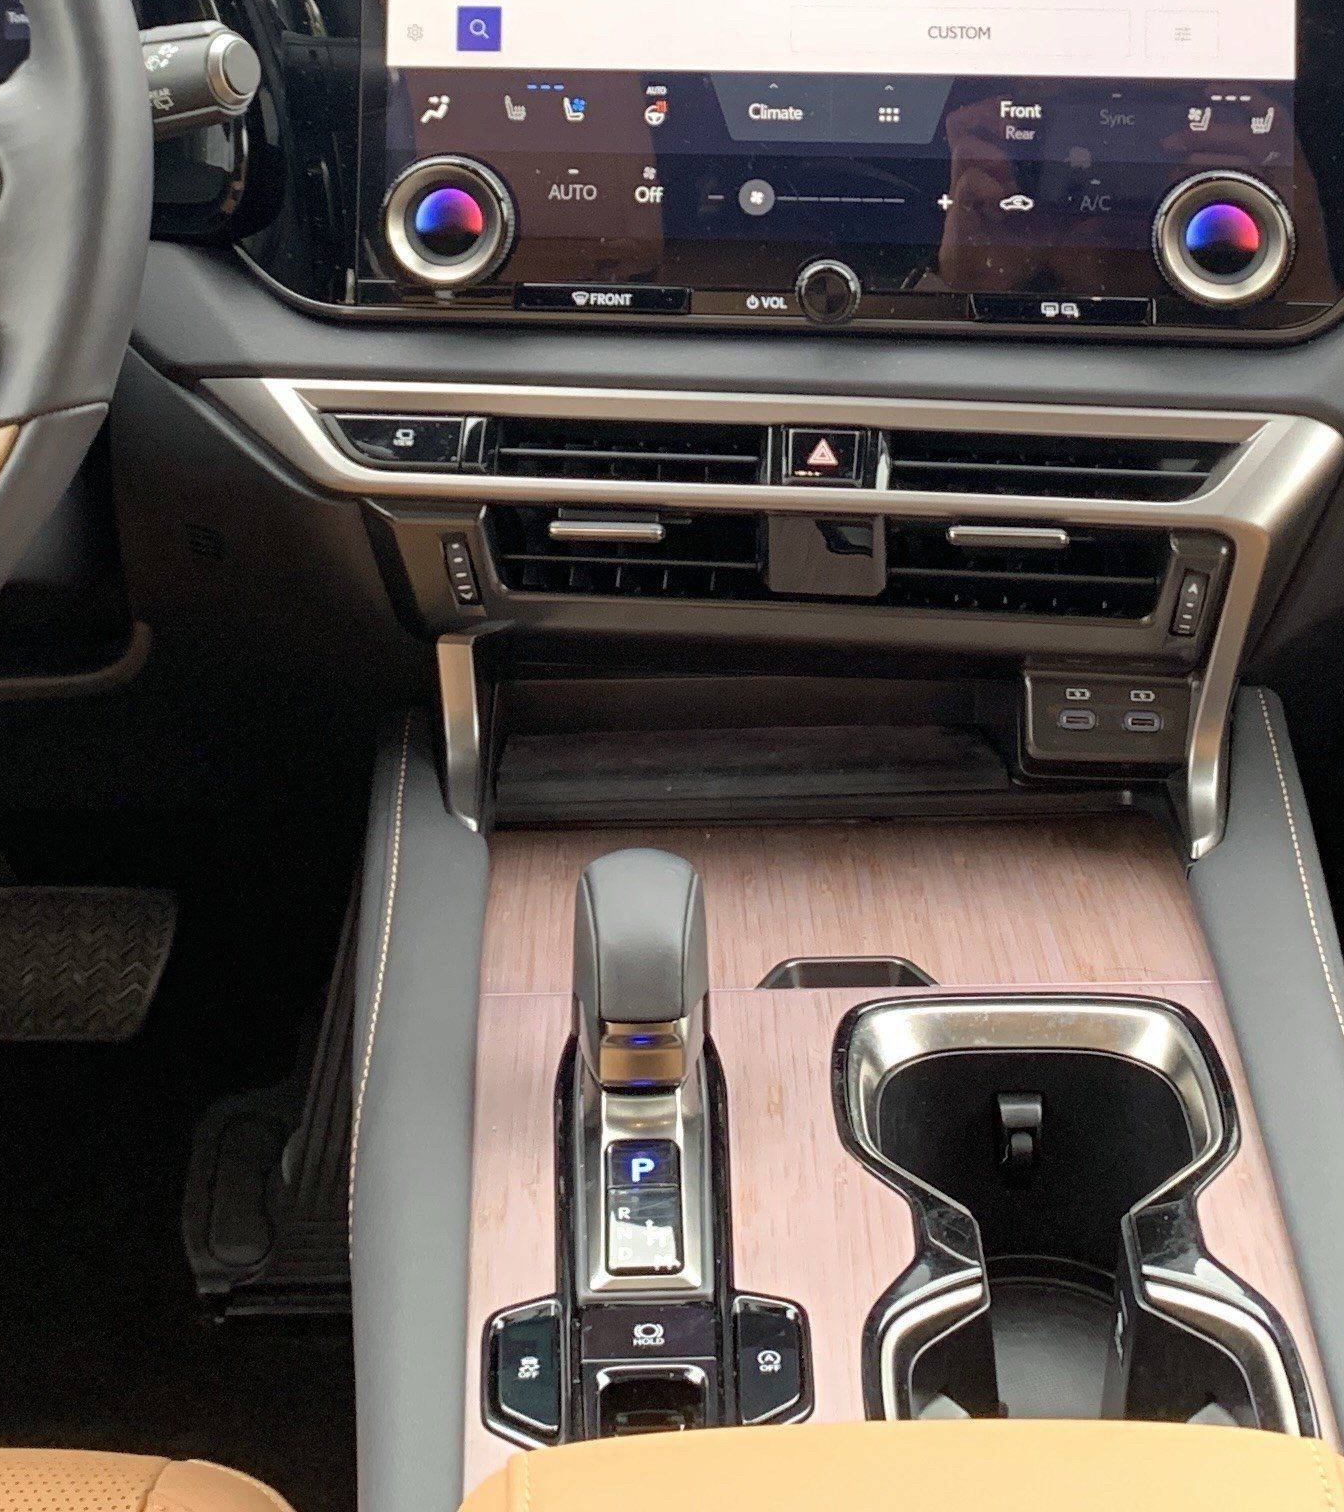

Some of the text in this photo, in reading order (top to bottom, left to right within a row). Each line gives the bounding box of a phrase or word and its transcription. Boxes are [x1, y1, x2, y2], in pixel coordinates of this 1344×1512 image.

[927, 25, 991, 42] CUSTOM
[646, 86, 667, 94] AUTO
[749, 104, 803, 121] Climate
[1001, 102, 1041, 120] Front
[1099, 109, 1135, 127] Sync
[1006, 125, 1035, 140] Rear
[549, 183, 597, 201] AUTO
[635, 186, 663, 204] Off
[1080, 194, 1110, 212] A/C
[590, 293, 632, 307] FRONT
[761, 296, 787, 309] VOL
[632, 1157, 655, 1182] P
[618, 1206, 631, 1219] R
[633, 1338, 664, 1346] HOLD
[518, 1370, 538, 1379] OFF
[759, 1364, 781, 1373] OFF
